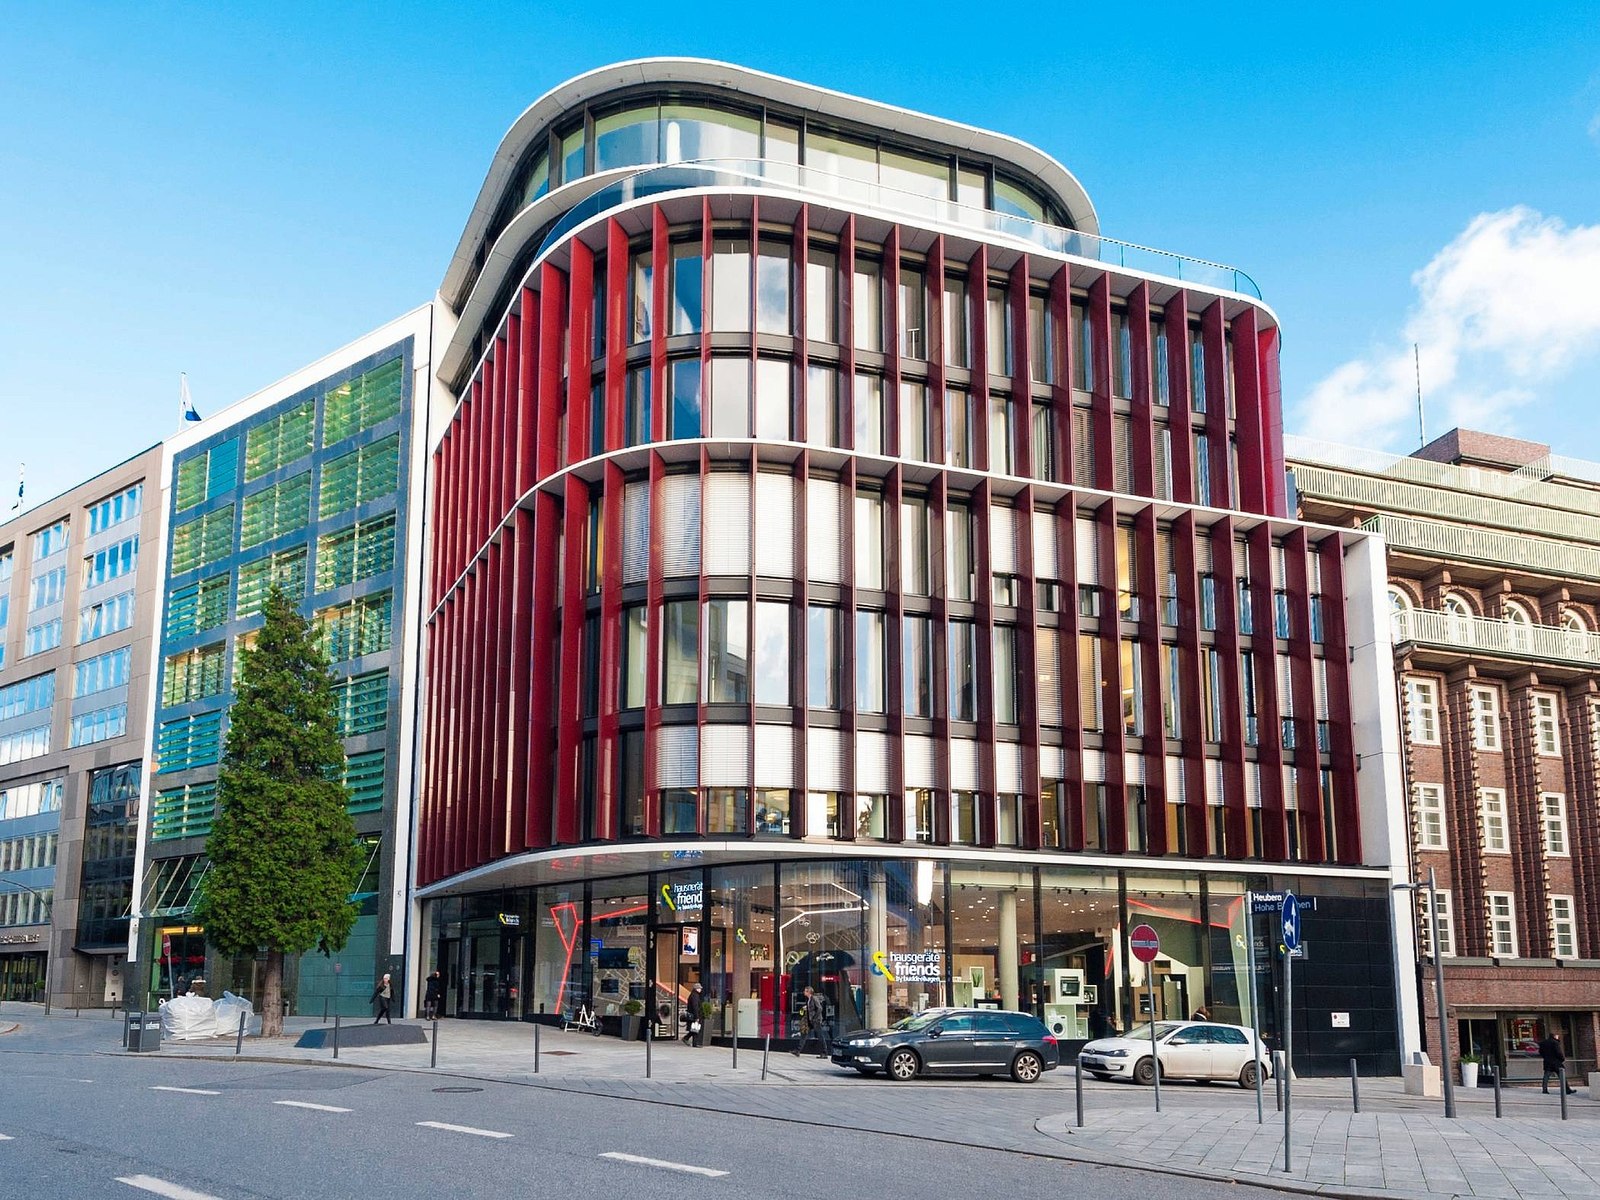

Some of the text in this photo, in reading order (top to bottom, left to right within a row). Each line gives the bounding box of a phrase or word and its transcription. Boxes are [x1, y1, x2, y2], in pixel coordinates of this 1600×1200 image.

[677, 890, 703, 904] friend
[1255, 903, 1275, 912] Hohe
[890, 951, 940, 964] hausgeräte
[895, 962, 940, 976] friends
